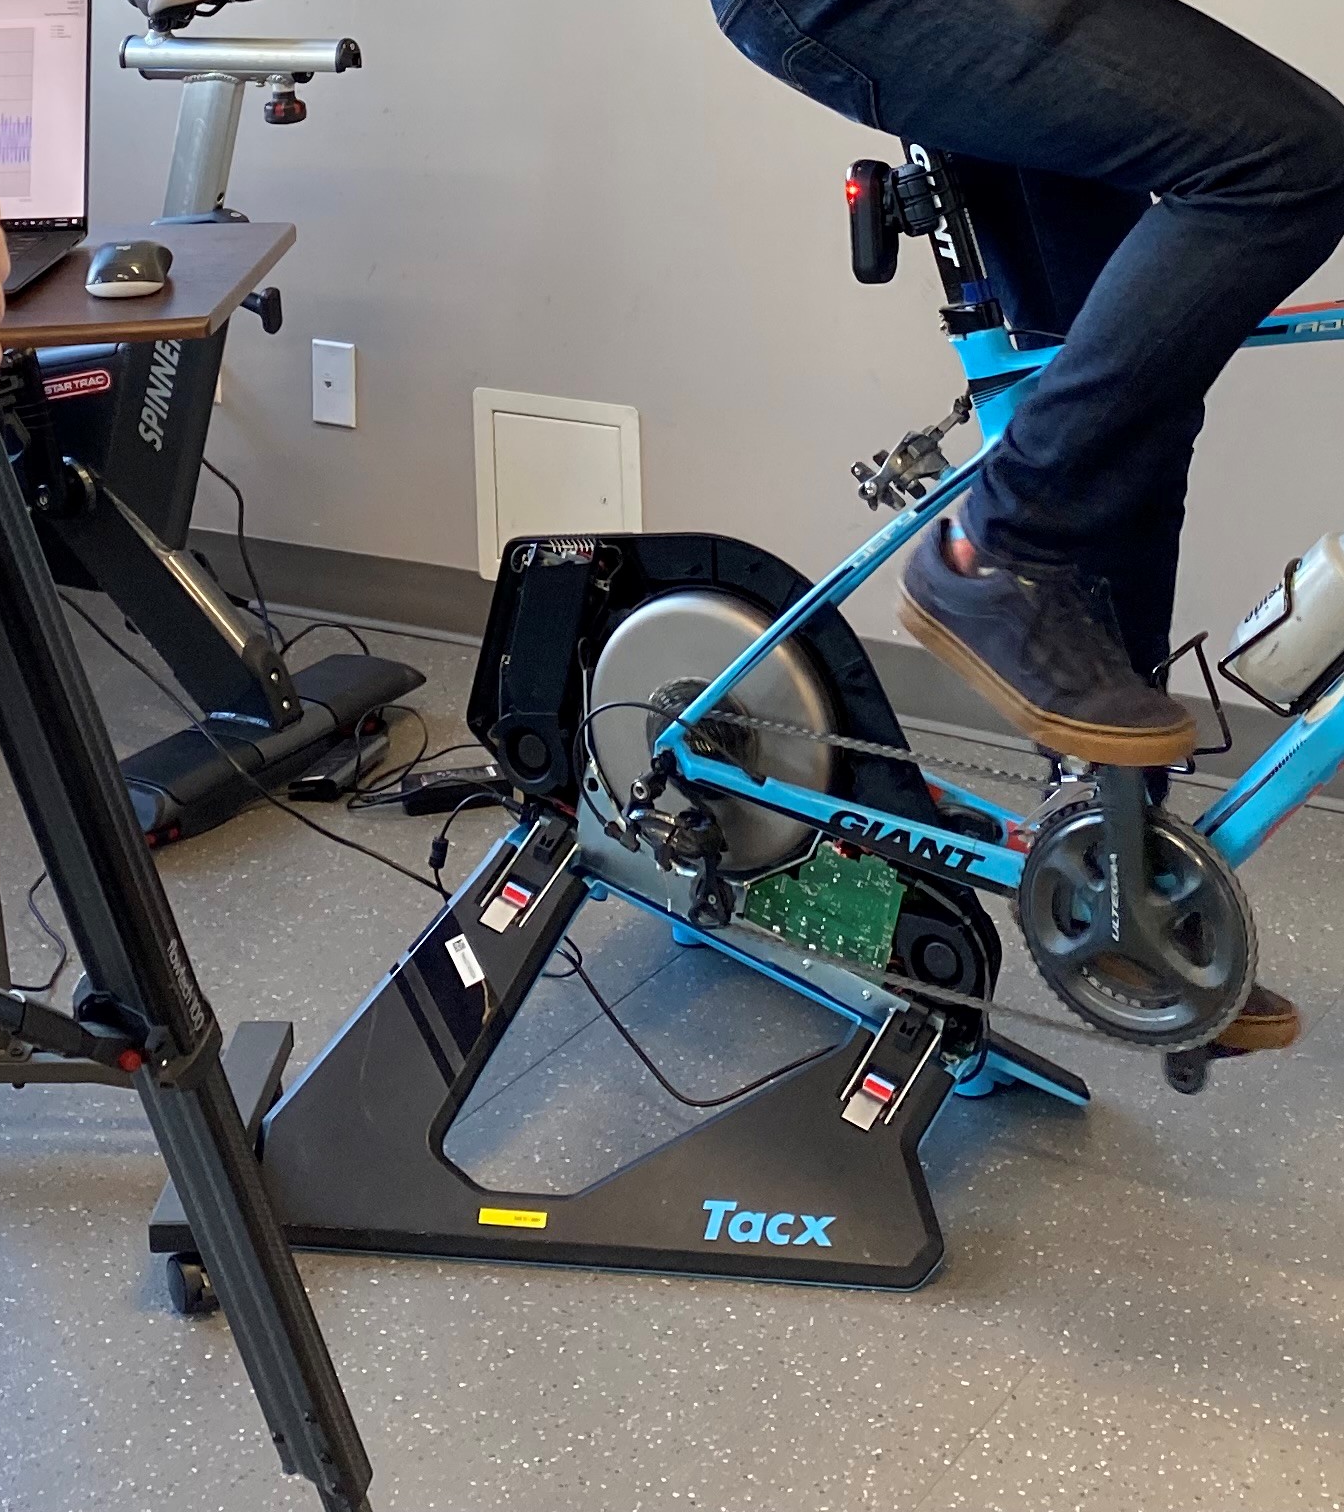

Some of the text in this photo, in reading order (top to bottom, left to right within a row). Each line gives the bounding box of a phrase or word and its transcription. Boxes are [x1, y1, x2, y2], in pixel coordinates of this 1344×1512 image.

[43, 374, 106, 395] STAR TRAC
[828, 809, 987, 874] GIANT
[702, 1199, 837, 1248] Tacx
